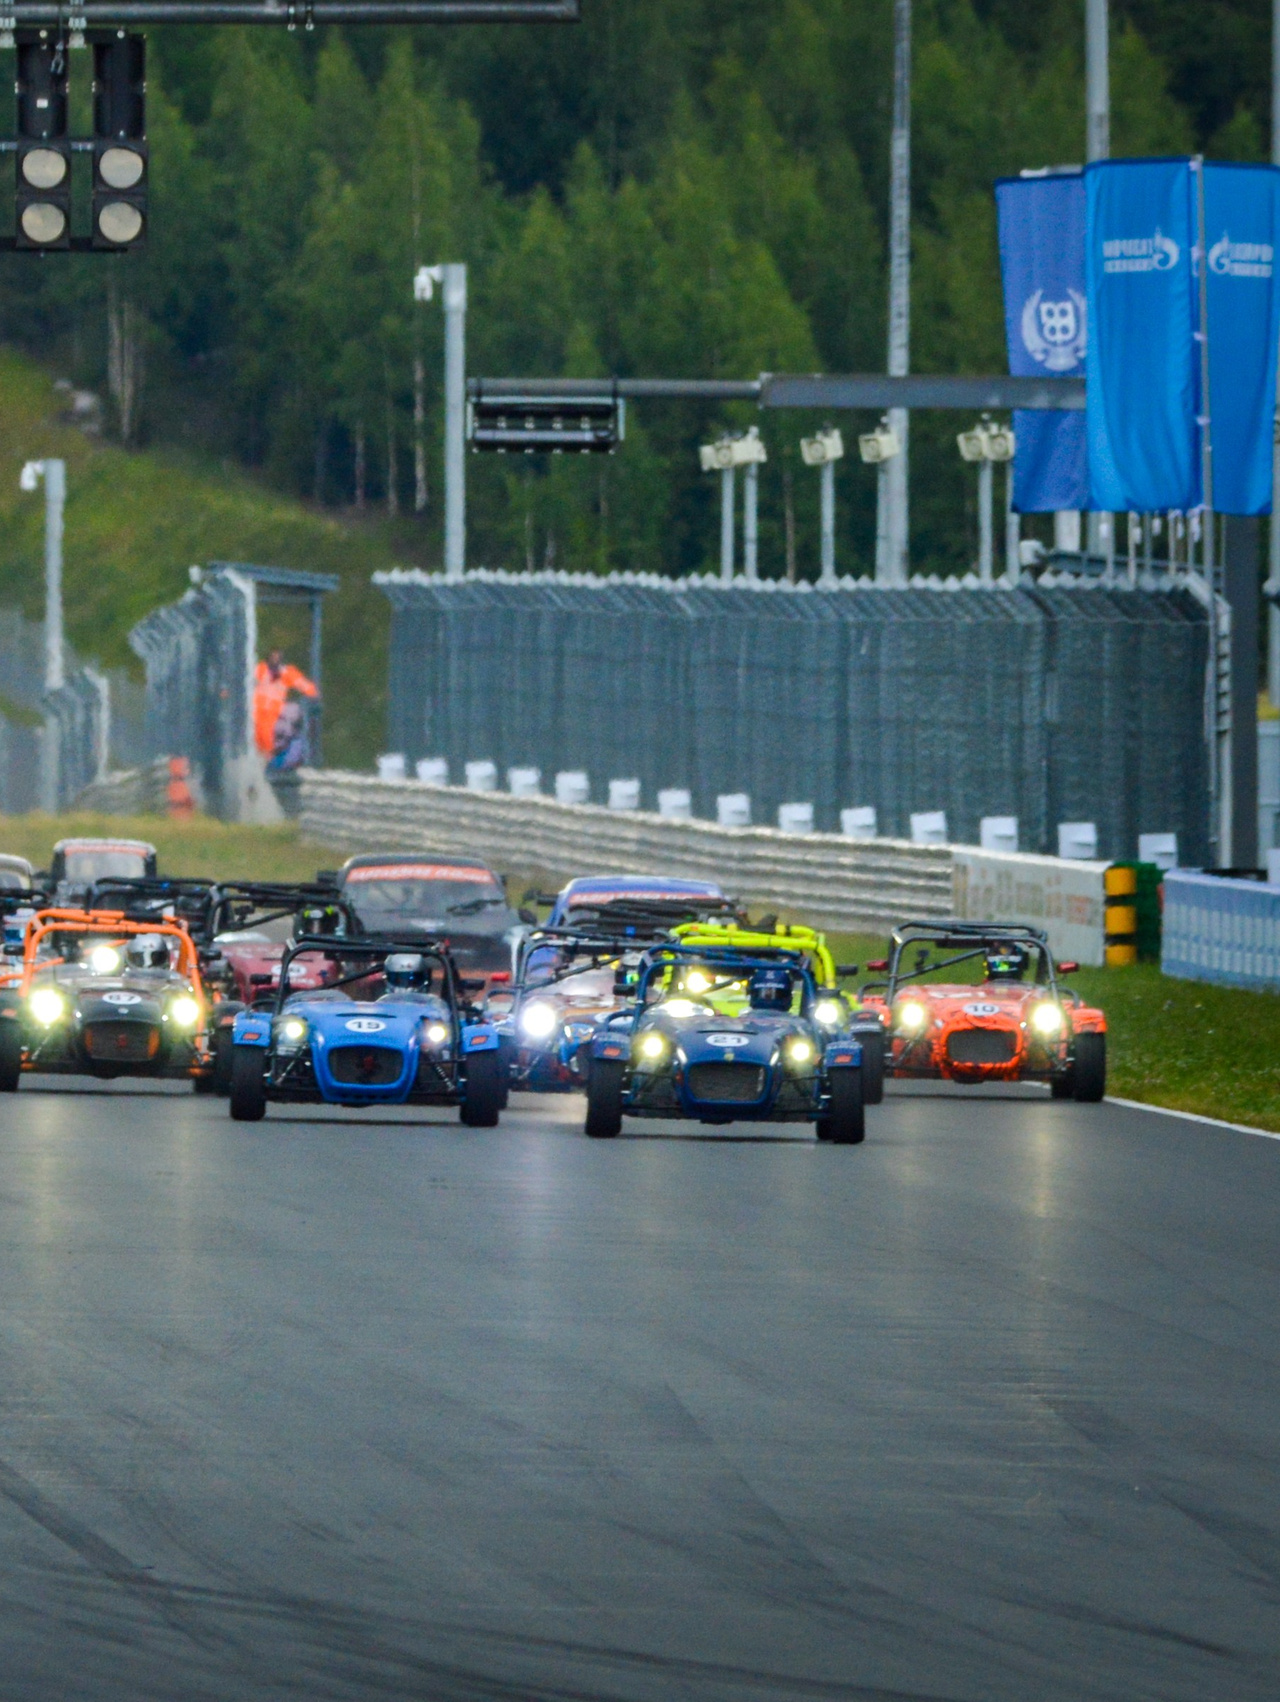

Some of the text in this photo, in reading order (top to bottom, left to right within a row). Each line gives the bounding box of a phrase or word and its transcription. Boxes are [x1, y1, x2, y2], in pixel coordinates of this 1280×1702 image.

[967, 1004, 995, 1013] 10
[351, 1020, 380, 1029] 19
[713, 1036, 742, 1044] 21
